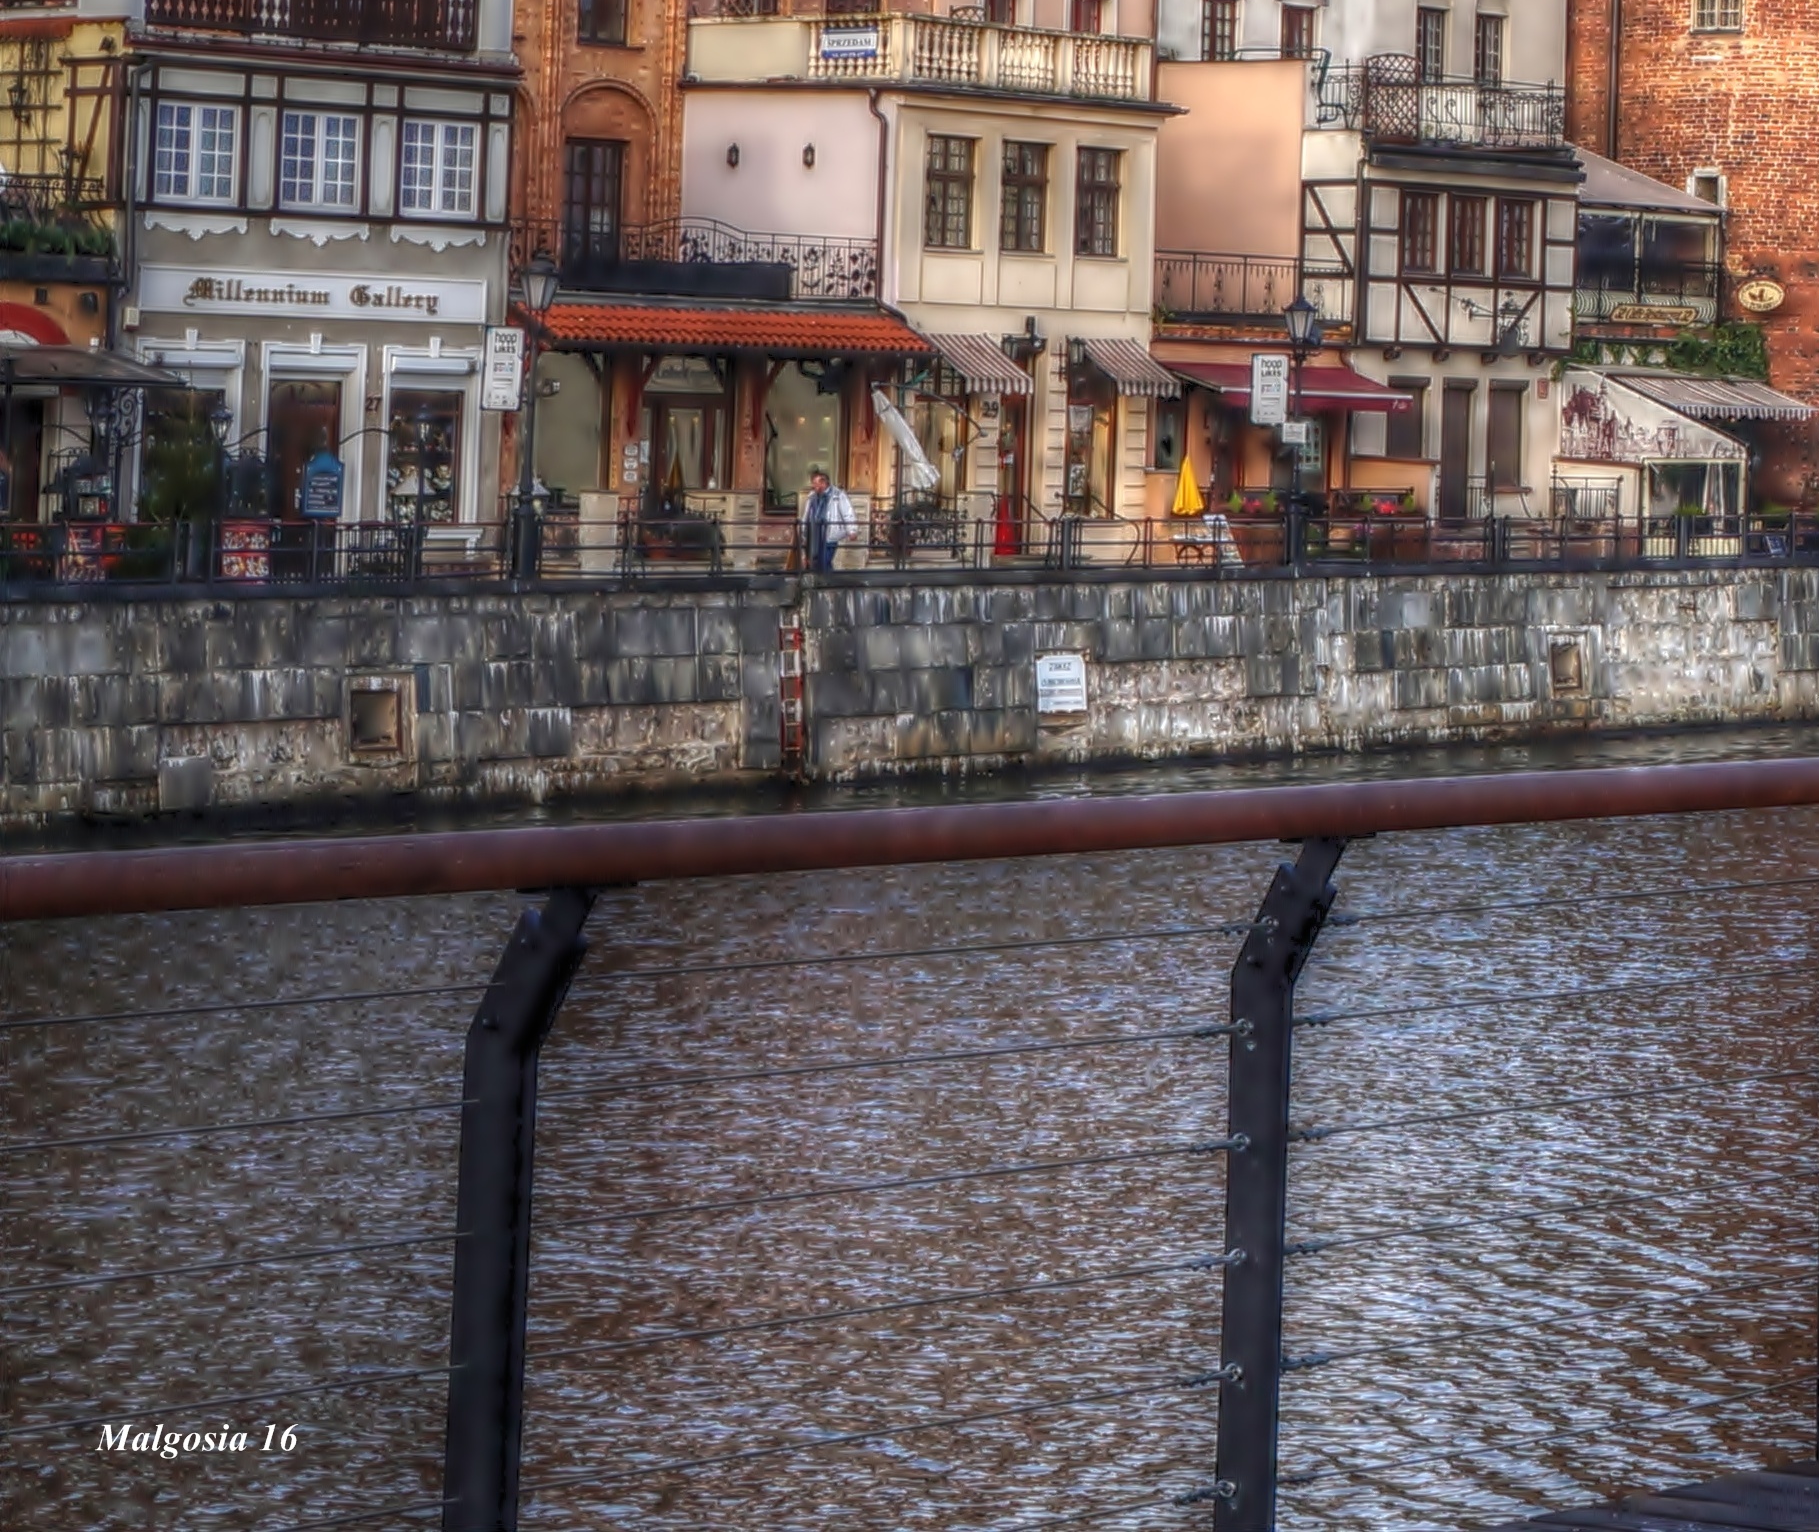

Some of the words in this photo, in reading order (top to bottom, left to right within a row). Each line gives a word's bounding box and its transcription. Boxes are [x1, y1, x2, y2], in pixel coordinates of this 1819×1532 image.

[828, 38, 872, 48] SPRZEDAM
[183, 276, 331, 306] Millennium
[350, 284, 440, 315] Gallery
[982, 400, 999, 418] 29
